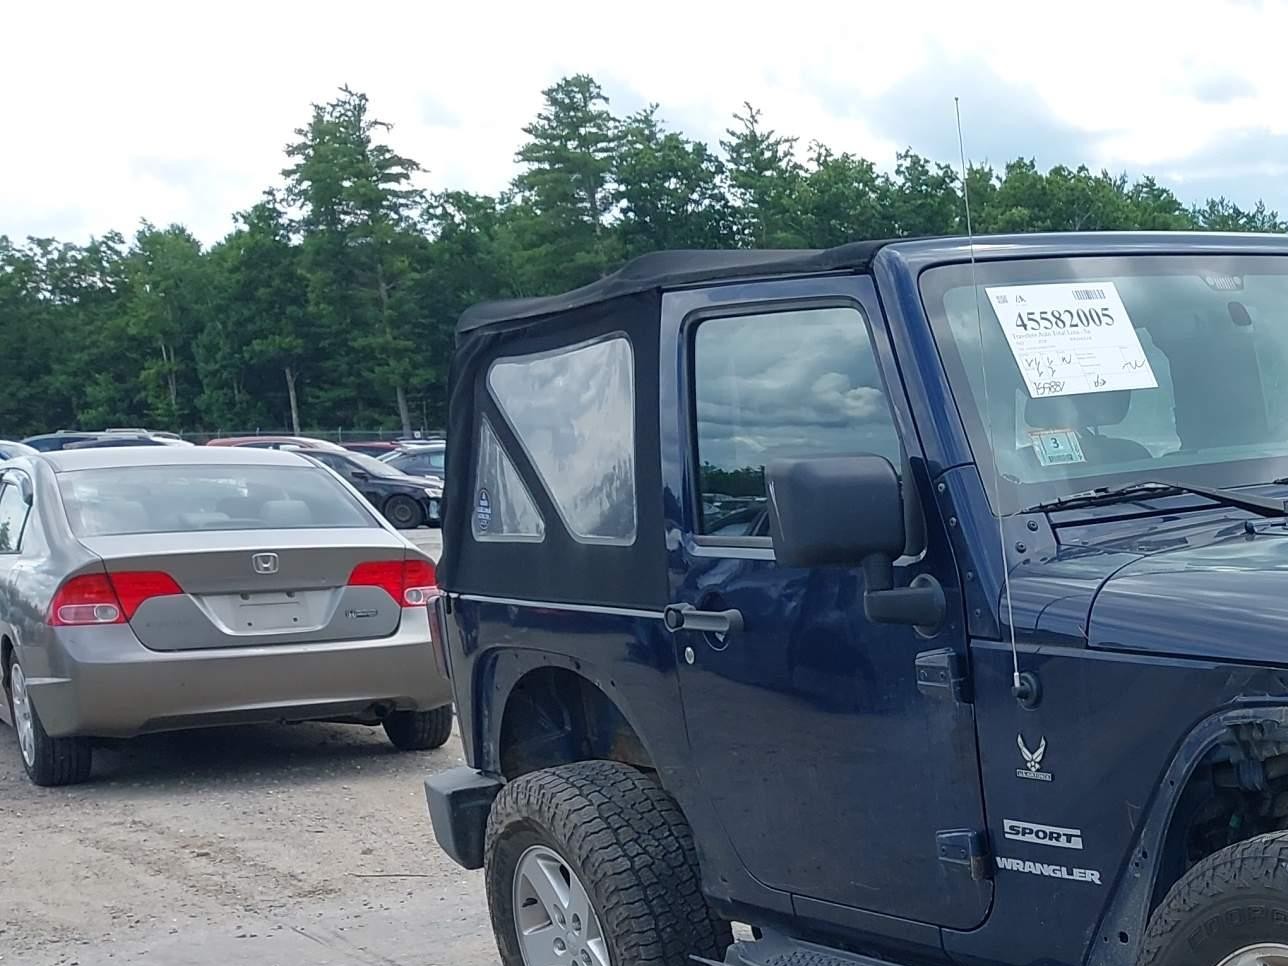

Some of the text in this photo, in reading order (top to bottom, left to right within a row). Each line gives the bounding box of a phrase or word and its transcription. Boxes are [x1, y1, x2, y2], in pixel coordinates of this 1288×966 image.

[1015, 307, 1115, 332] 45582005
[1050, 437, 1060, 449] 3
[1008, 824, 1074, 844] SPORT
[995, 856, 1103, 885] WRANGLER
